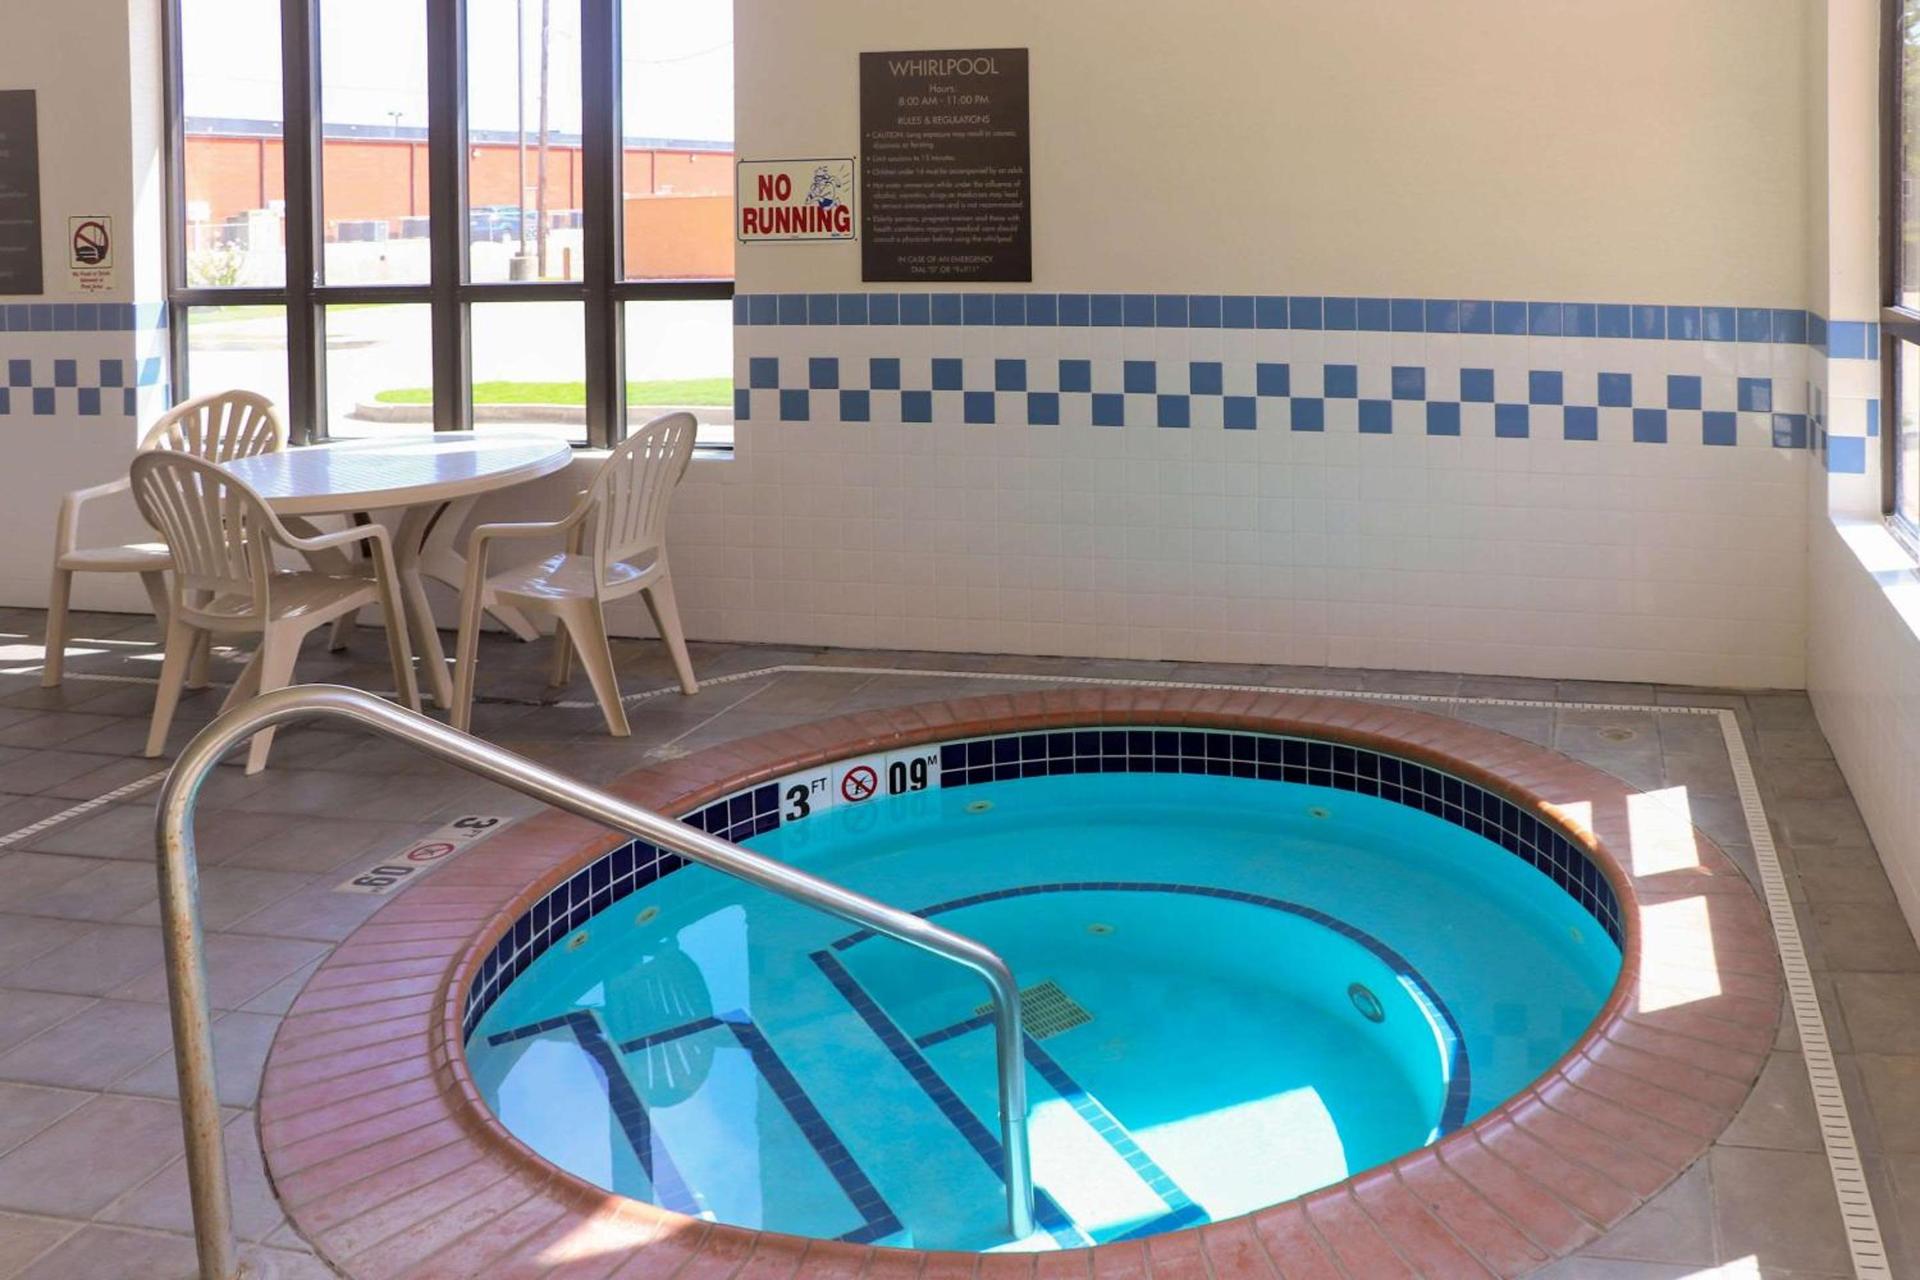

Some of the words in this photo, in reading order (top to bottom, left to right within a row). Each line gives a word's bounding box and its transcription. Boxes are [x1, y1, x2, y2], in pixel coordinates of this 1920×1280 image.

[888, 57, 999, 77] WHIRLPOOL
[921, 96, 938, 105] AM
[974, 95, 990, 104] PM
[898, 116, 922, 125] RULES
[932, 115, 990, 124] REGULATIONS
[758, 174, 791, 201] NO
[743, 205, 850, 234] RUNNING
[786, 785, 810, 822] 3
[811, 777, 827, 794] FT
[454, 817, 498, 828] 3
